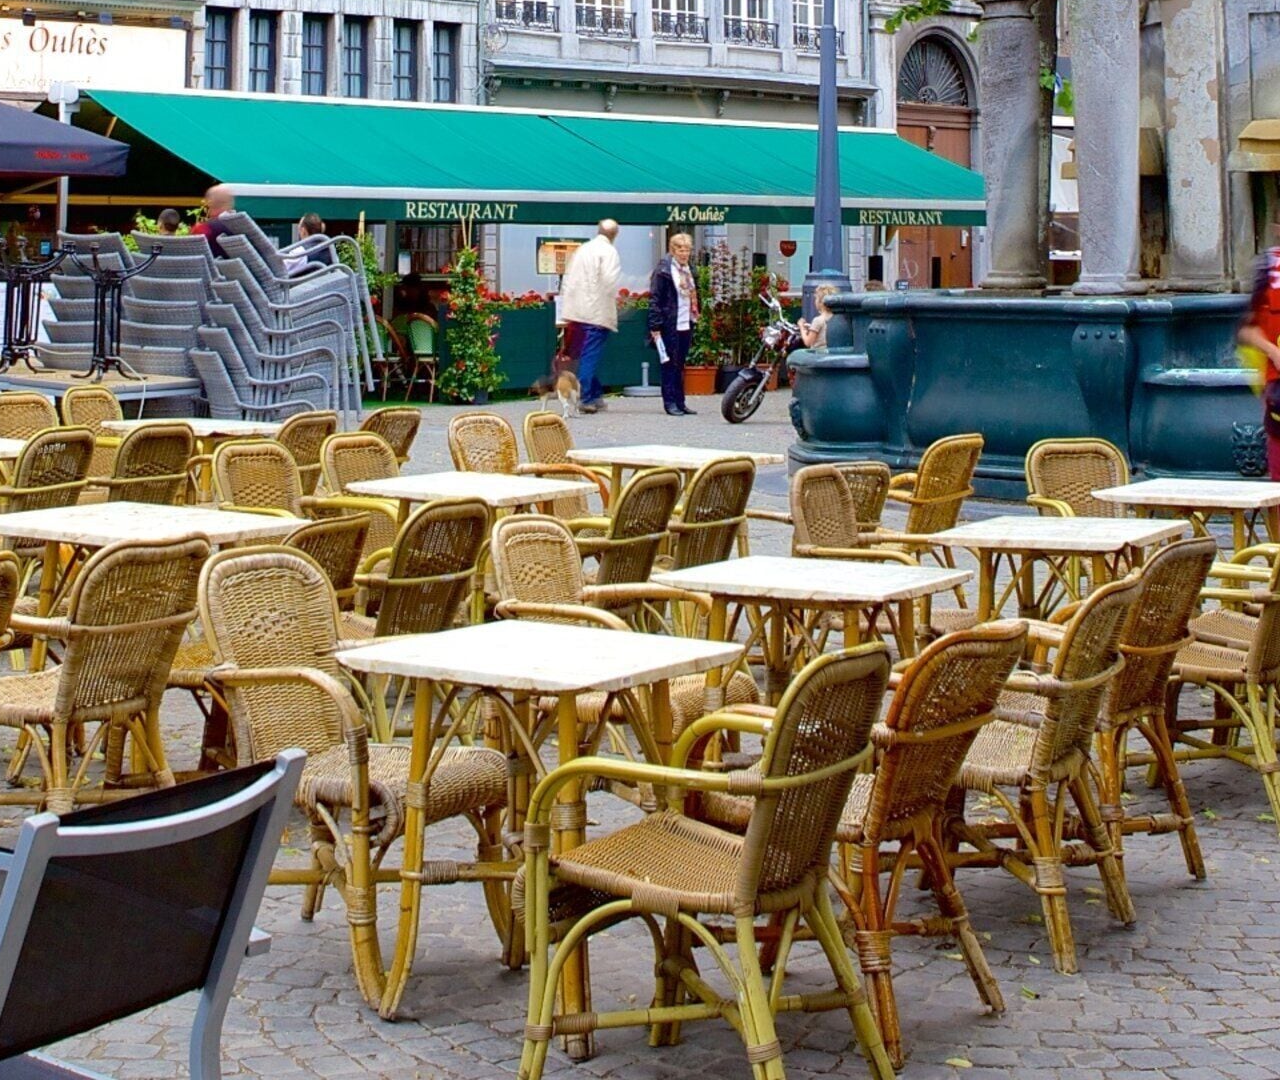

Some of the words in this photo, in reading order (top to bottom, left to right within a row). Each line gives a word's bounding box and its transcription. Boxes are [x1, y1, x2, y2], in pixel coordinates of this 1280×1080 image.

[29, 22, 108, 56] Ouhès
[405, 201, 518, 221] RESTAURANT
[859, 209, 943, 226] RESTAURANT
